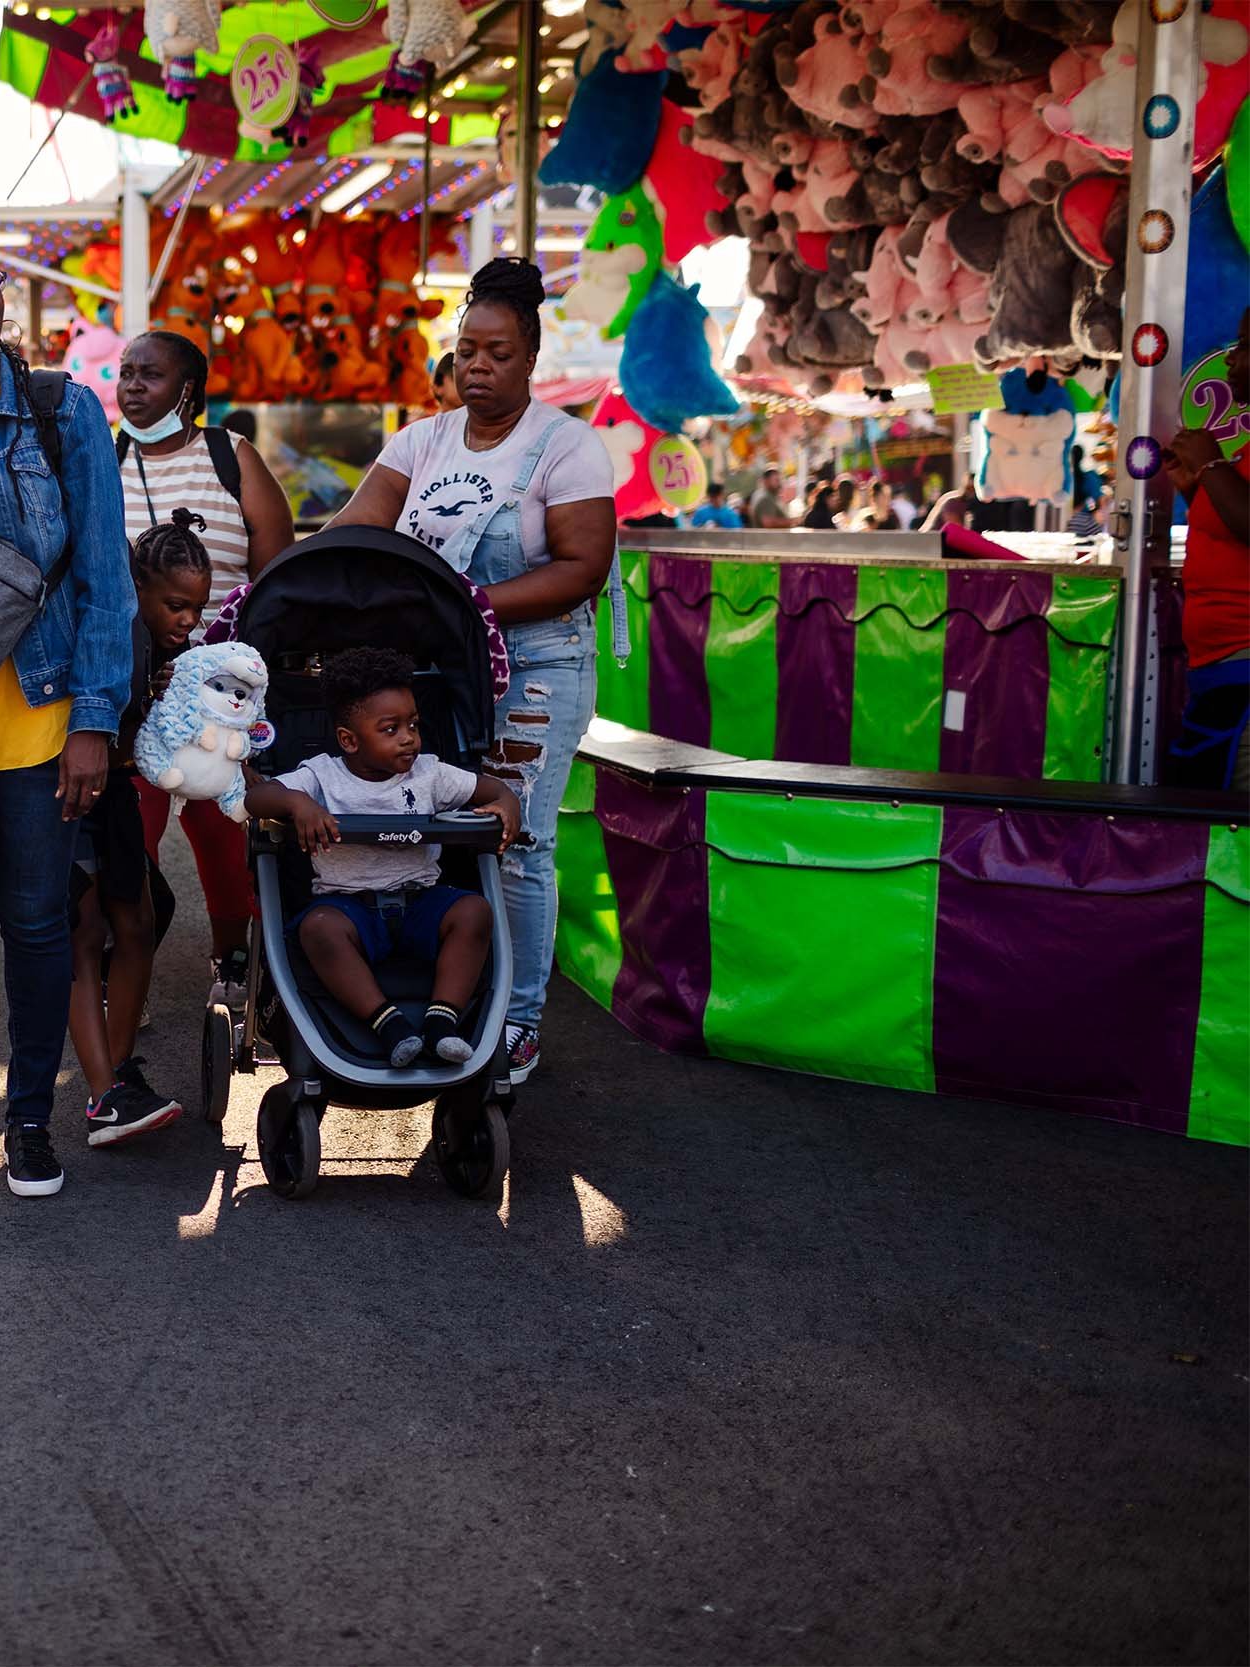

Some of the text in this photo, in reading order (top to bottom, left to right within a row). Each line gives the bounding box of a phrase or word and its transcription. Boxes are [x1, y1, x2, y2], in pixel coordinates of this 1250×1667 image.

[419, 472, 493, 504] HOLLISTER
[409, 509, 445, 550] CALIF
[378, 832, 408, 842] Safety
